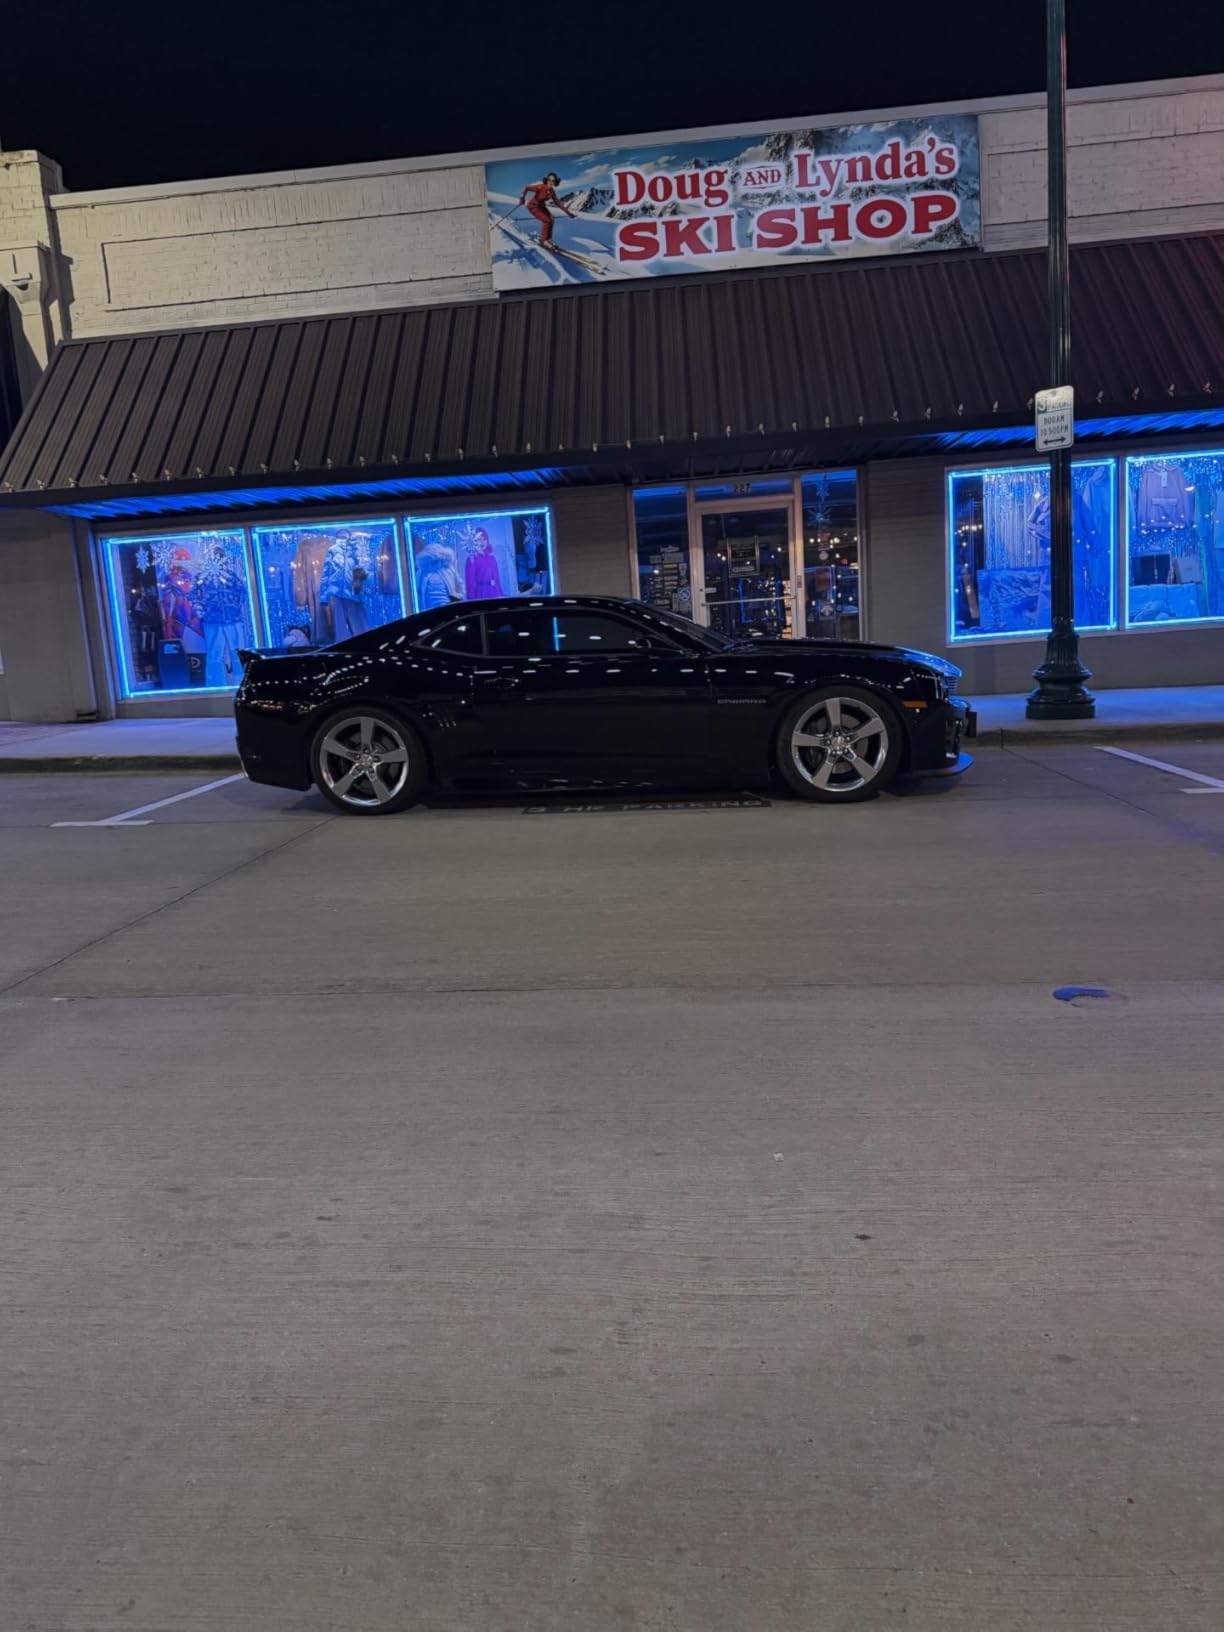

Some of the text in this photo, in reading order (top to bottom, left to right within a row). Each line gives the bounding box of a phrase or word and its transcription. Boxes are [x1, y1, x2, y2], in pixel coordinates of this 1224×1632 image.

[614, 137, 957, 208] Doug AND Lynda's
[618, 194, 957, 262] SKI SHOP
